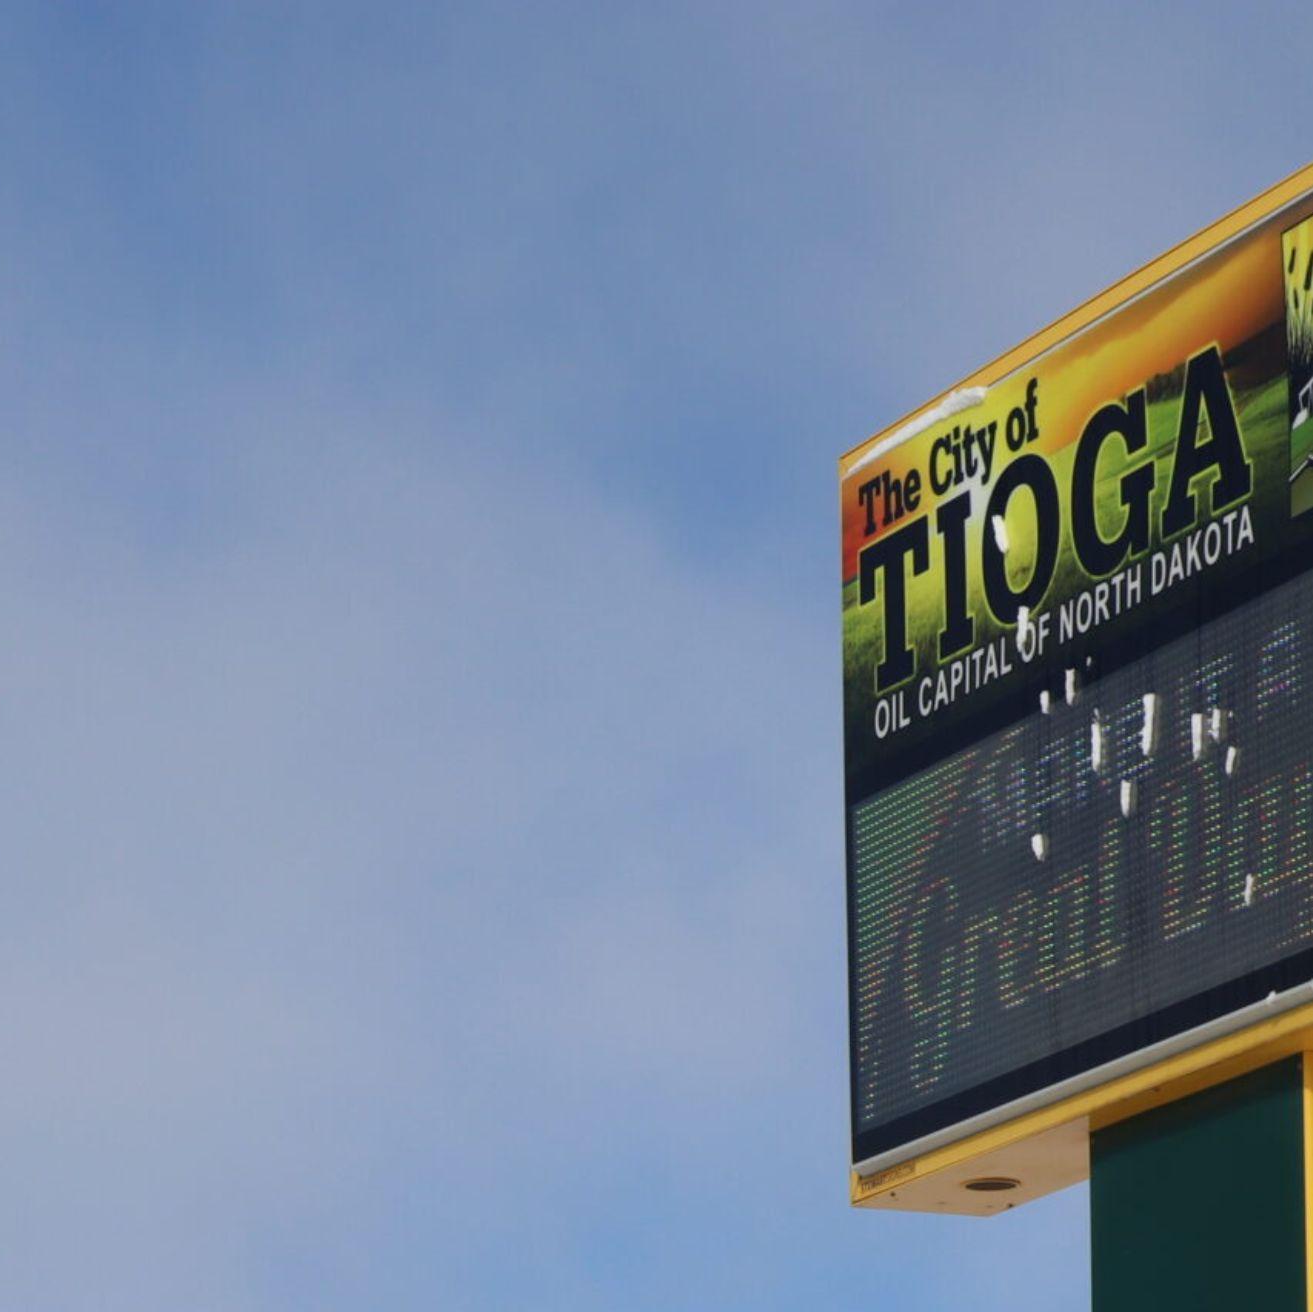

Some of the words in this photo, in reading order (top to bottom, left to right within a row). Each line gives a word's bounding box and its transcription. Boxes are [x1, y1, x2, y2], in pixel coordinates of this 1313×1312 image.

[859, 469, 922, 537] The
[929, 419, 997, 498] City
[1006, 377, 1039, 450] of
[859, 342, 1253, 692] TIOGA
[874, 691, 911, 740] OIL
[918, 634, 1012, 717] CAPITAL
[1020, 617, 1051, 664] OF
[1059, 566, 1142, 645] NORTH
[1151, 505, 1255, 593] DAKOTA
